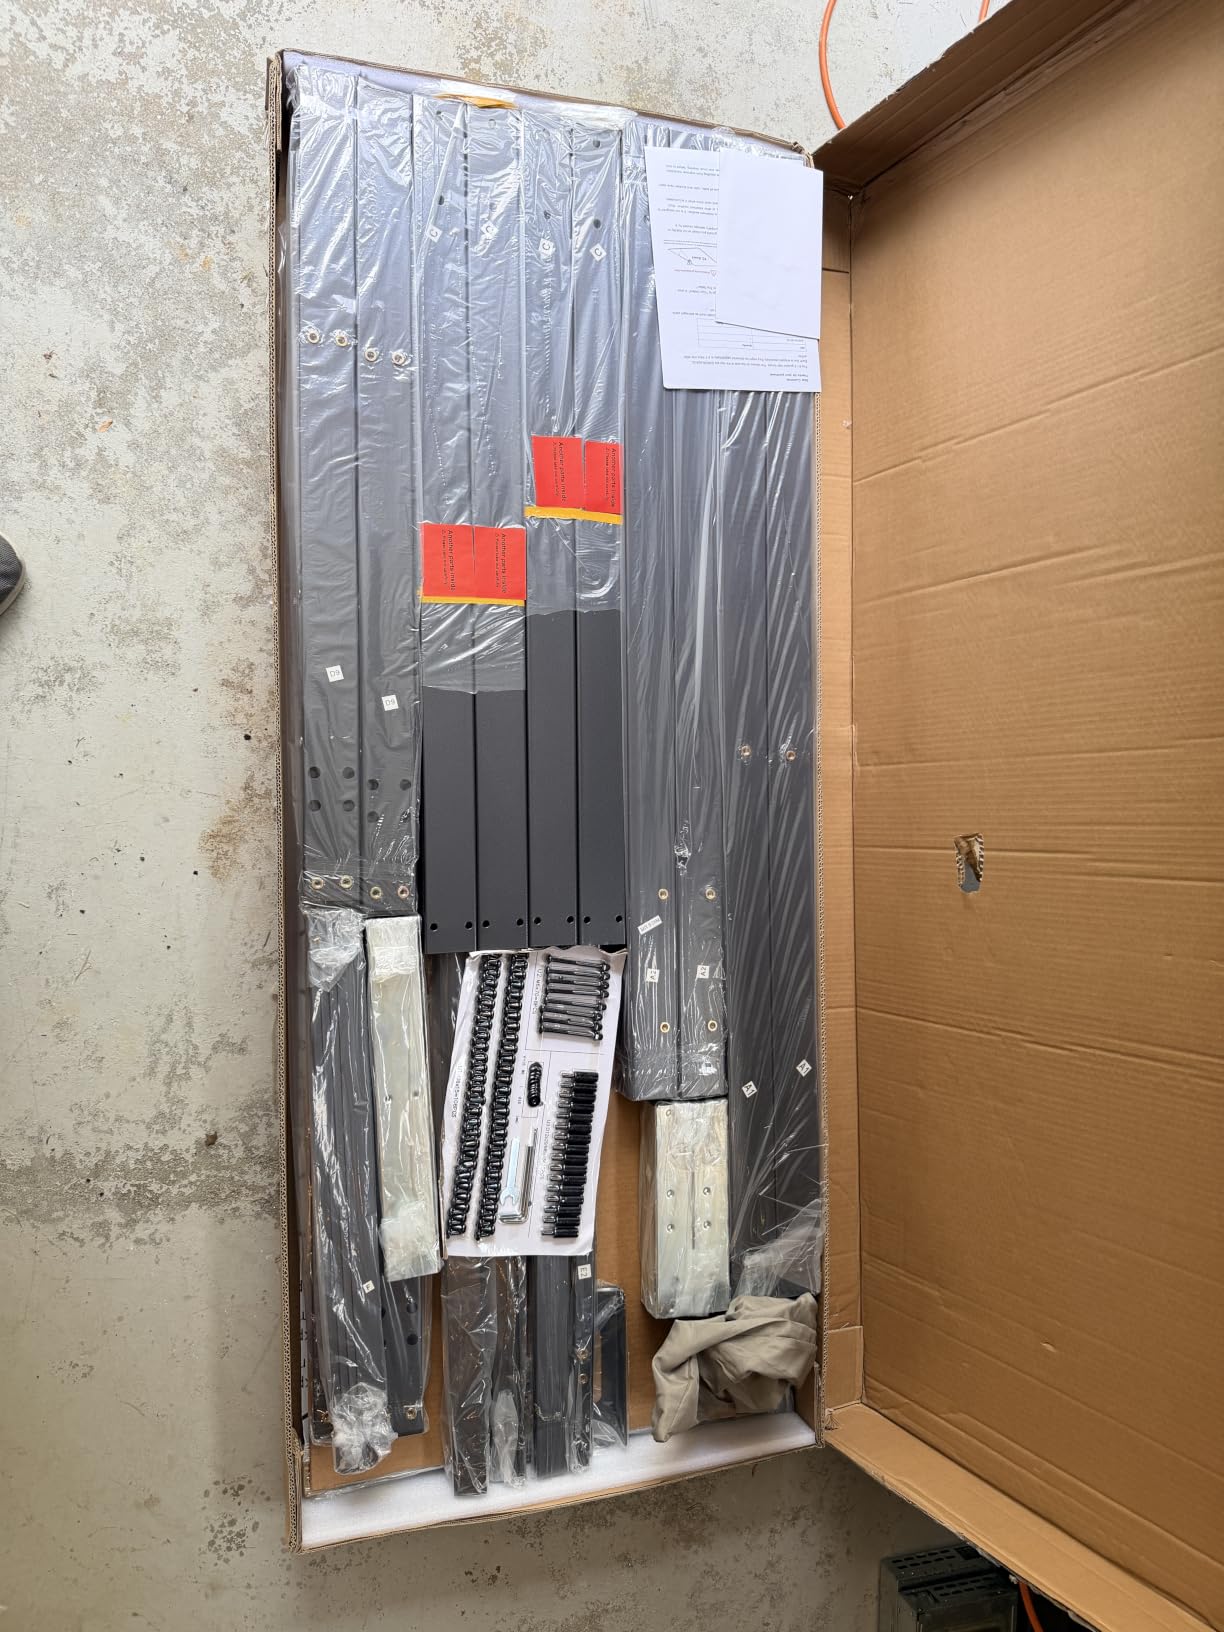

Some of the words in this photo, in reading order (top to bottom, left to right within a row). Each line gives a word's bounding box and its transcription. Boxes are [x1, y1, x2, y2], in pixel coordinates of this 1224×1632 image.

[650, 970, 657, 980] A2
[700, 966, 707, 976] A2
[799, 1062, 810, 1074] A1
[744, 1084, 755, 1096] A1
